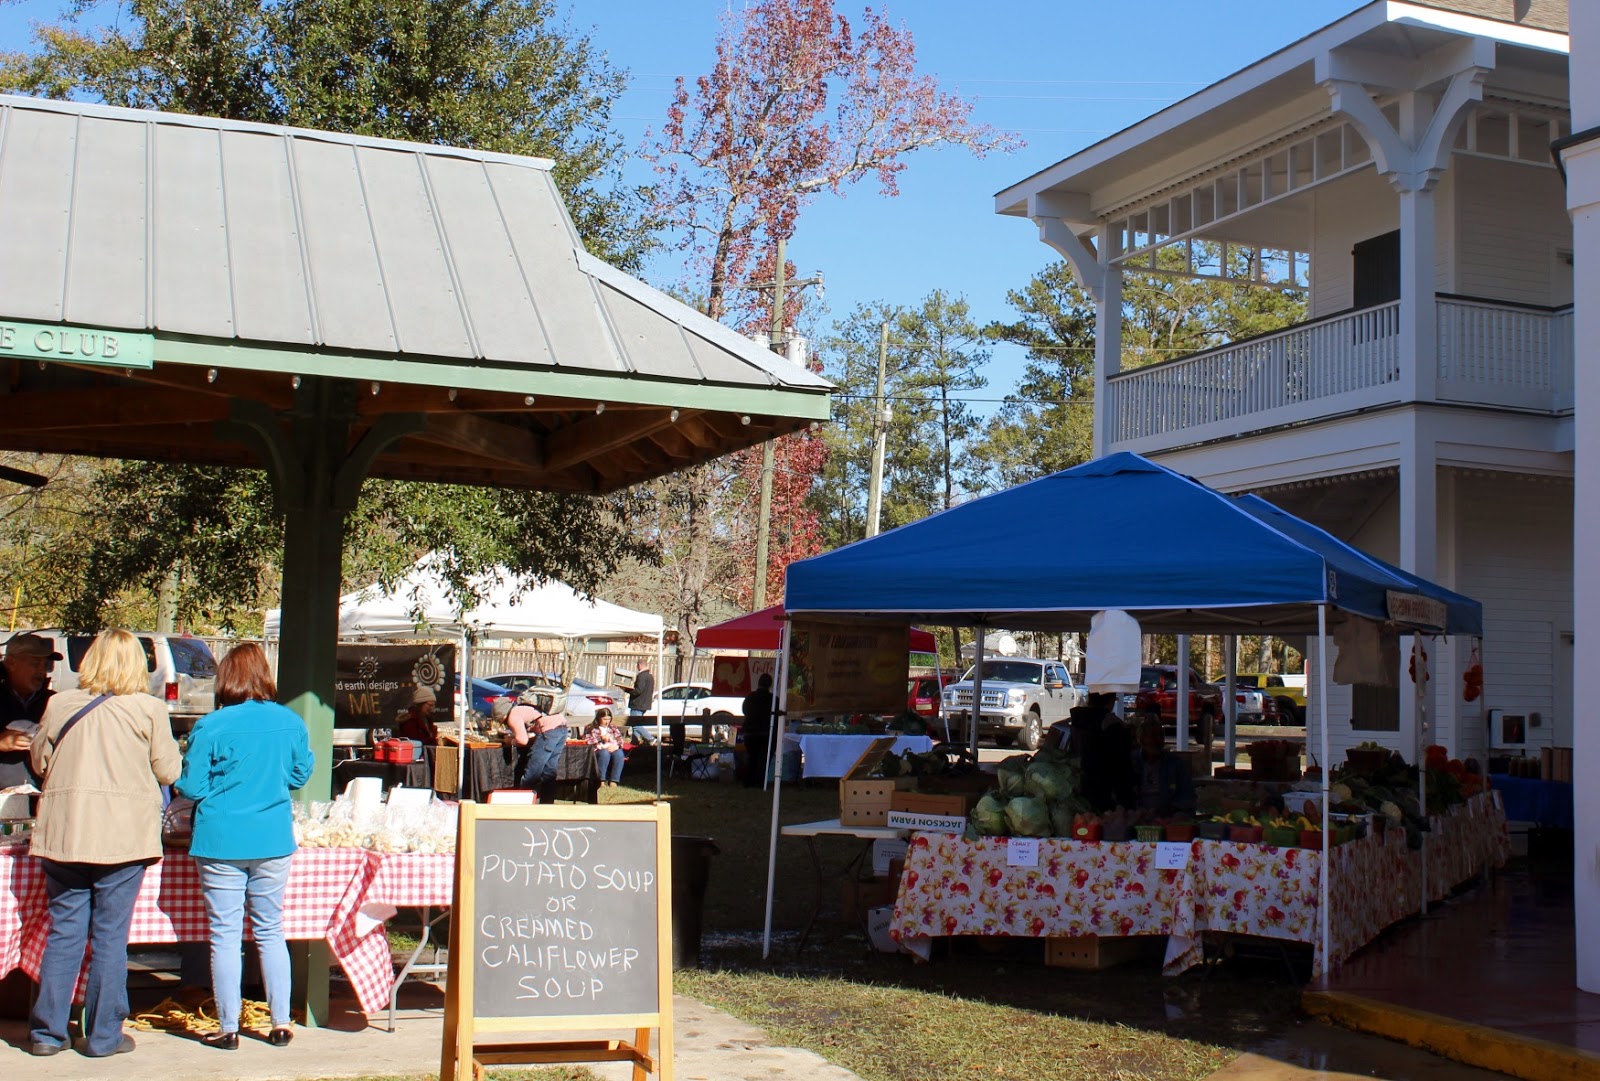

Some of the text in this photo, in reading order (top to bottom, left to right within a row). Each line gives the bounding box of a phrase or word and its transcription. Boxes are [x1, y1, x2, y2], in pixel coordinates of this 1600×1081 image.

[34, 330, 120, 358] CLUB
[344, 680, 366, 691] earth
[368, 679, 399, 692] designs
[348, 692, 382, 715] ME
[890, 815, 963, 829] JACKSON FARM
[522, 826, 597, 860] HOT
[480, 854, 655, 893] POTATO SOUP
[546, 895, 576, 913] OR
[480, 914, 594, 941] CREAMED
[481, 944, 639, 972] CALIFLOWER
[515, 975, 605, 1000] SOUP
